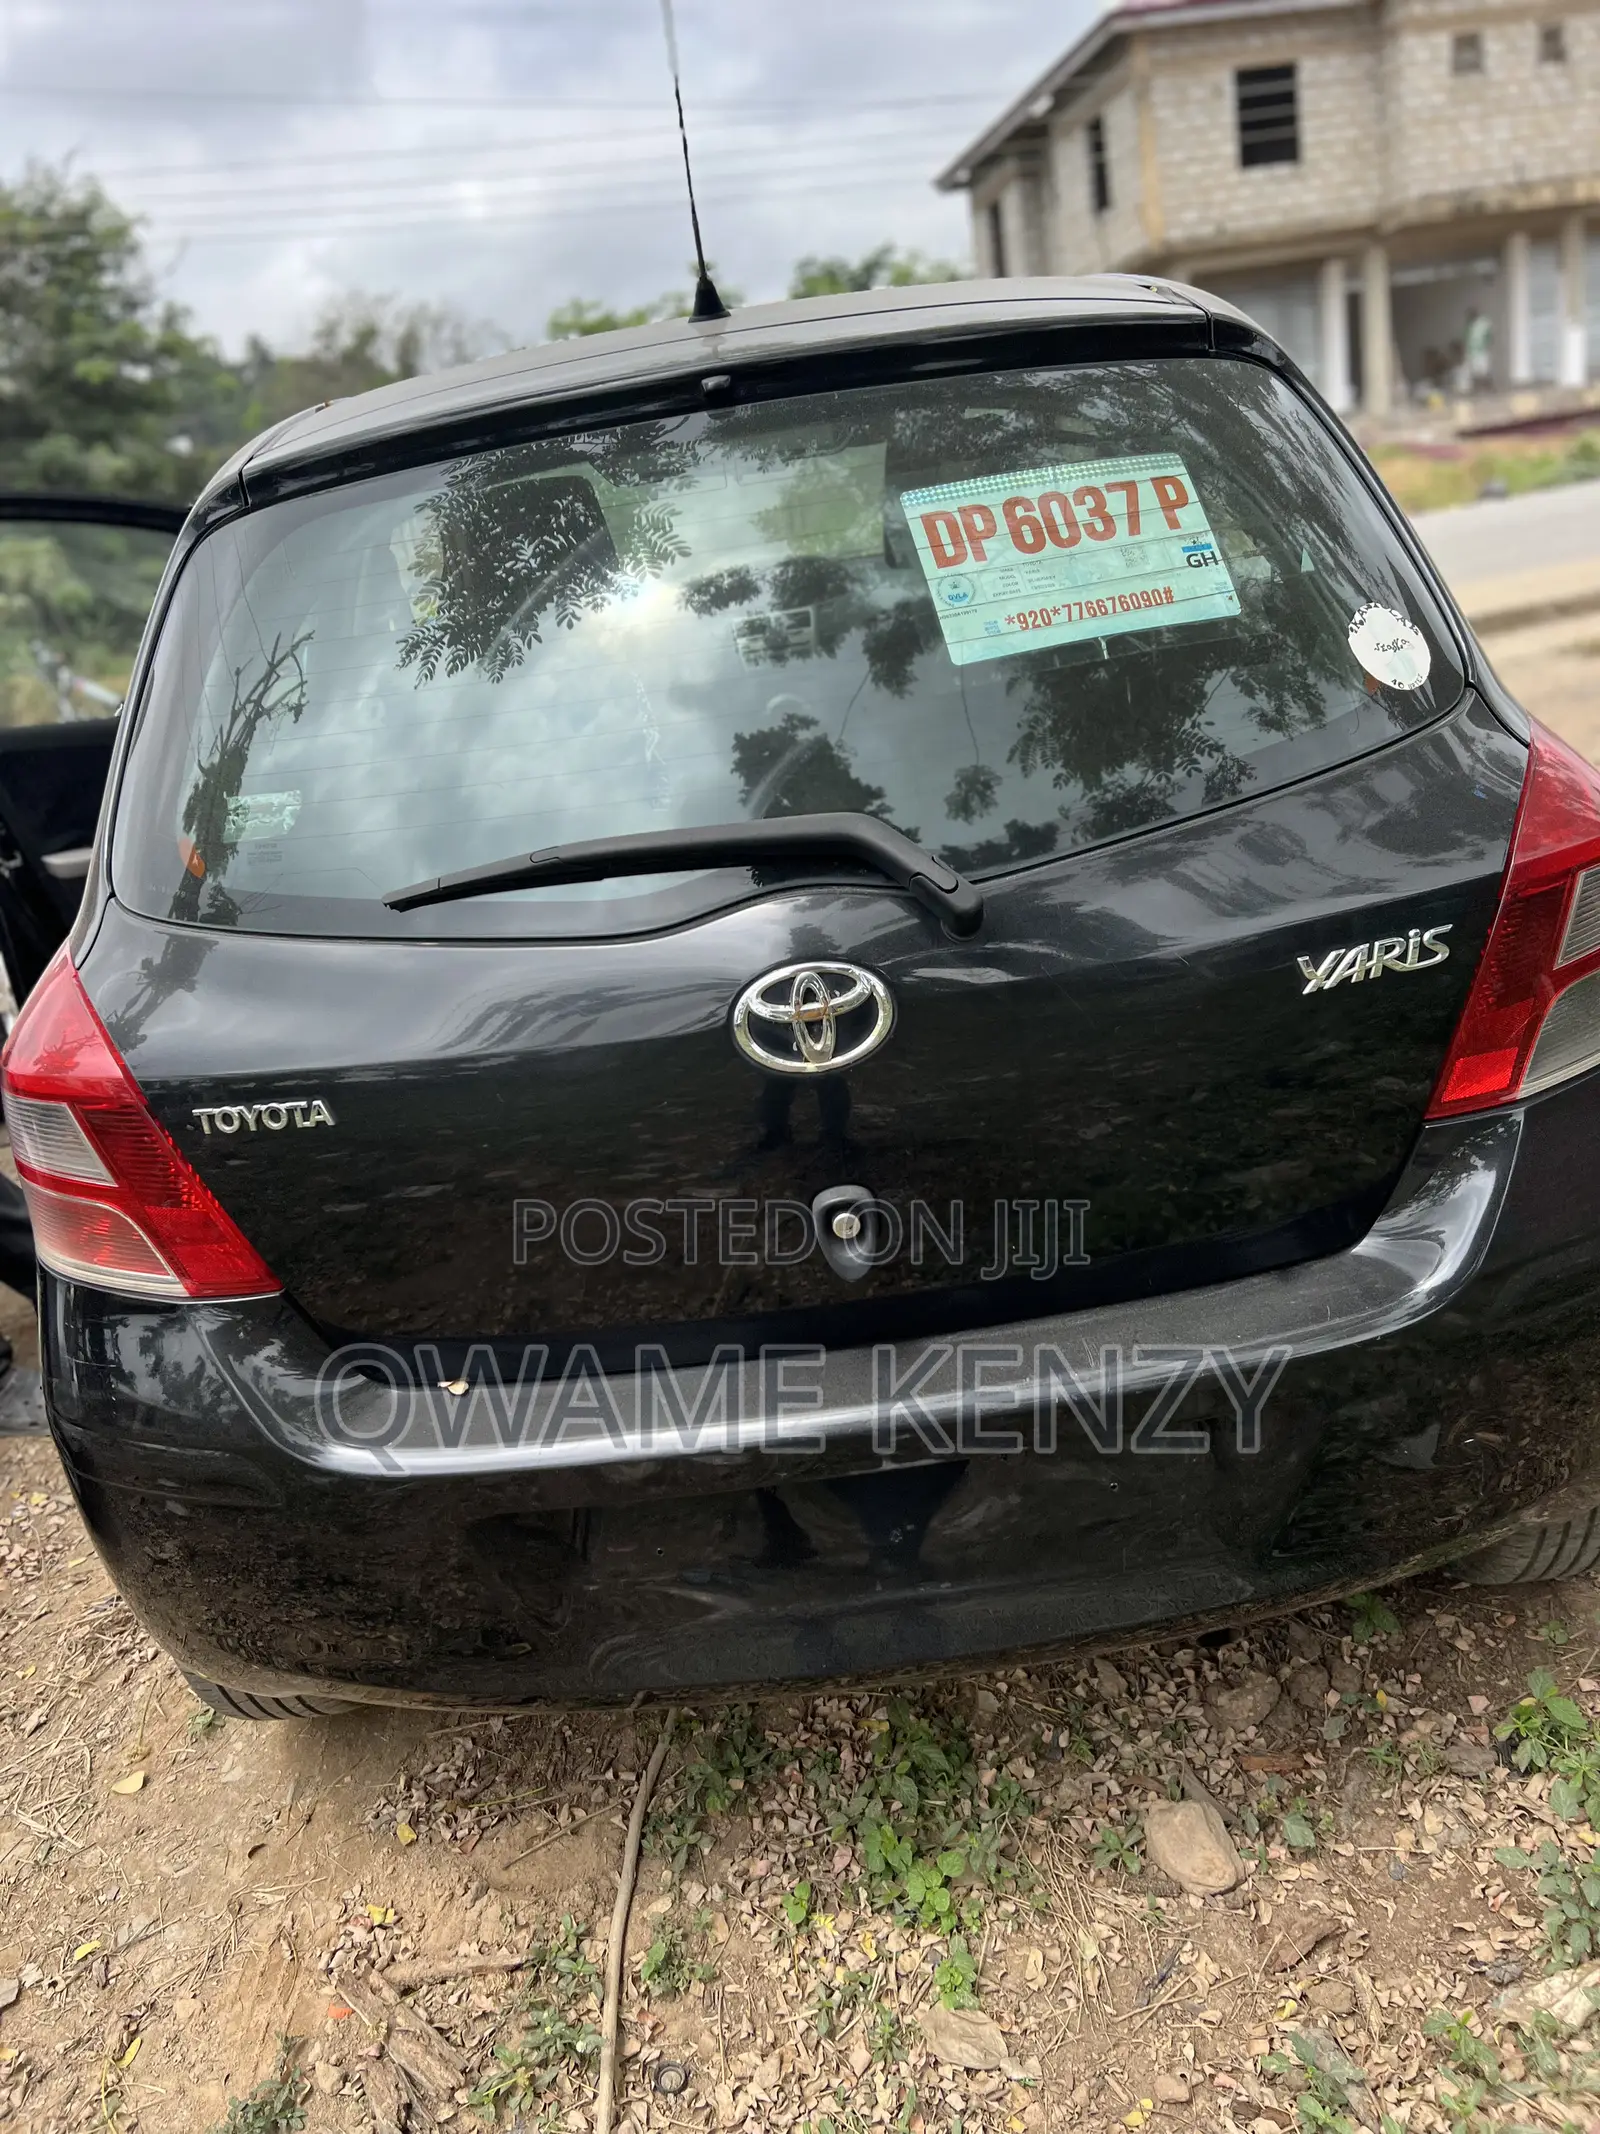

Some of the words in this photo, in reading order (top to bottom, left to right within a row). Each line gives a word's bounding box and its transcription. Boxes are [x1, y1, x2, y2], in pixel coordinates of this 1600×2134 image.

[920, 503, 997, 569] DP
[1002, 480, 1142, 555] 6037
[1150, 475, 1190, 531] P
[1186, 550, 1219, 569] GH
[191, 1100, 336, 1135] TOYOTA
